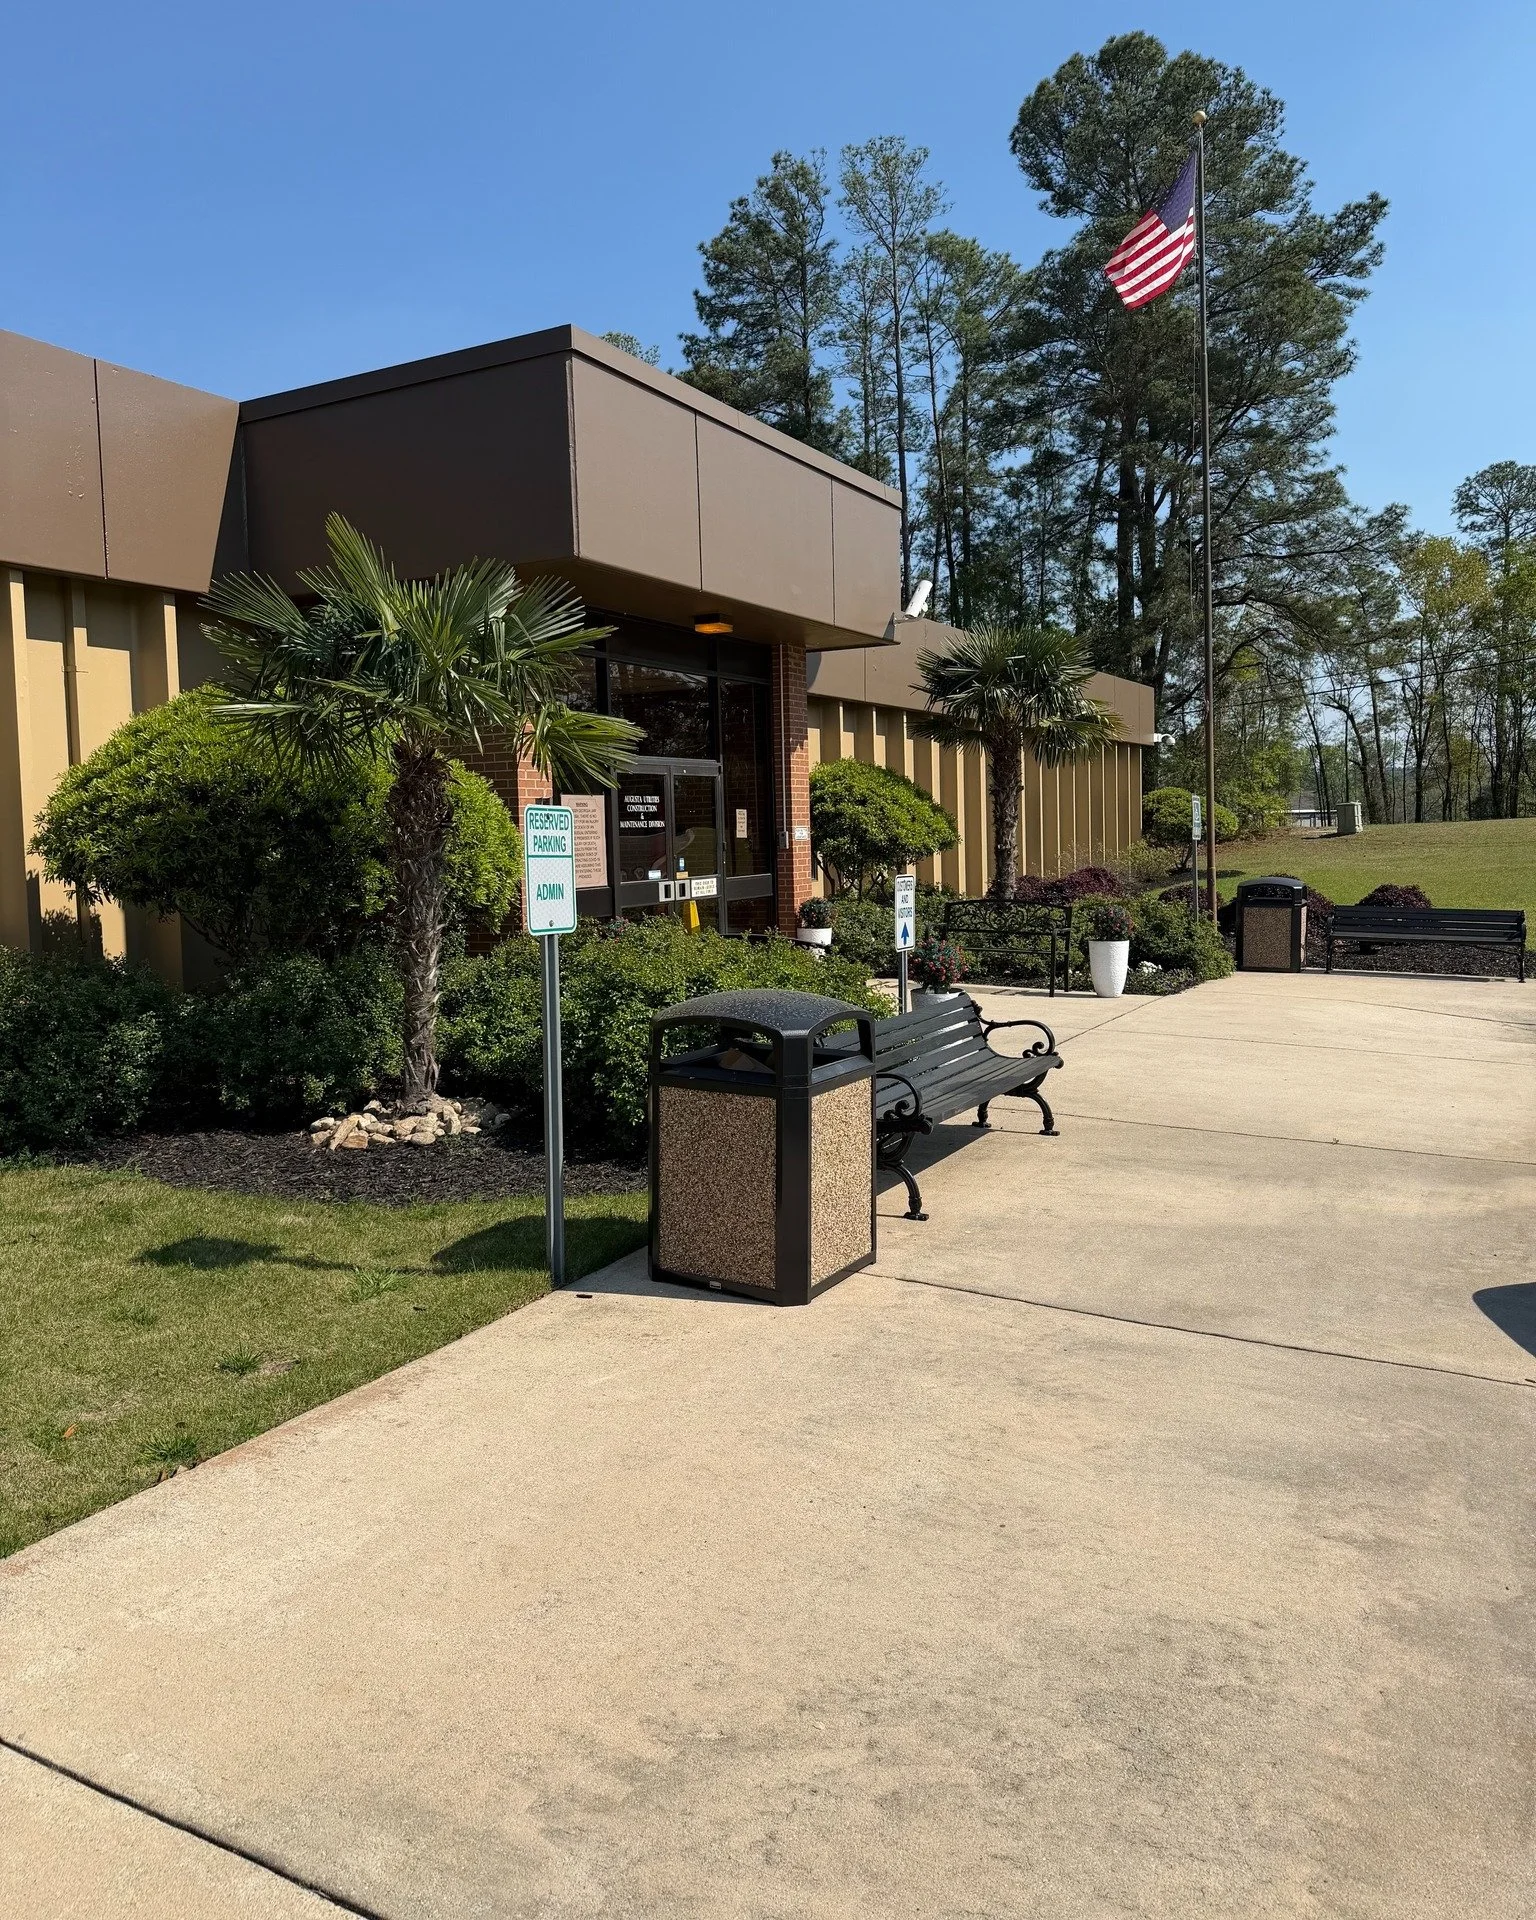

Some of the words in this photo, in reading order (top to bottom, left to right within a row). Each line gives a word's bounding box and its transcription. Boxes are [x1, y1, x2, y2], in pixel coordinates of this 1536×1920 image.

[624, 795, 643, 803] AUGUSTA
[643, 795, 660, 803] UTILITIES
[626, 804, 658, 812] CONSTRUCTION
[640, 812, 645, 820] &
[529, 812, 570, 831] RESERVED
[619, 820, 648, 828] MAINTENANCE
[648, 820, 666, 828] DIVISION
[533, 835, 567, 853] PARKING
[896, 880, 913, 892] CUSTOMERS
[536, 883, 565, 901] ADMIN
[901, 895, 909, 904] AND
[898, 906, 913, 919] VISITORS
